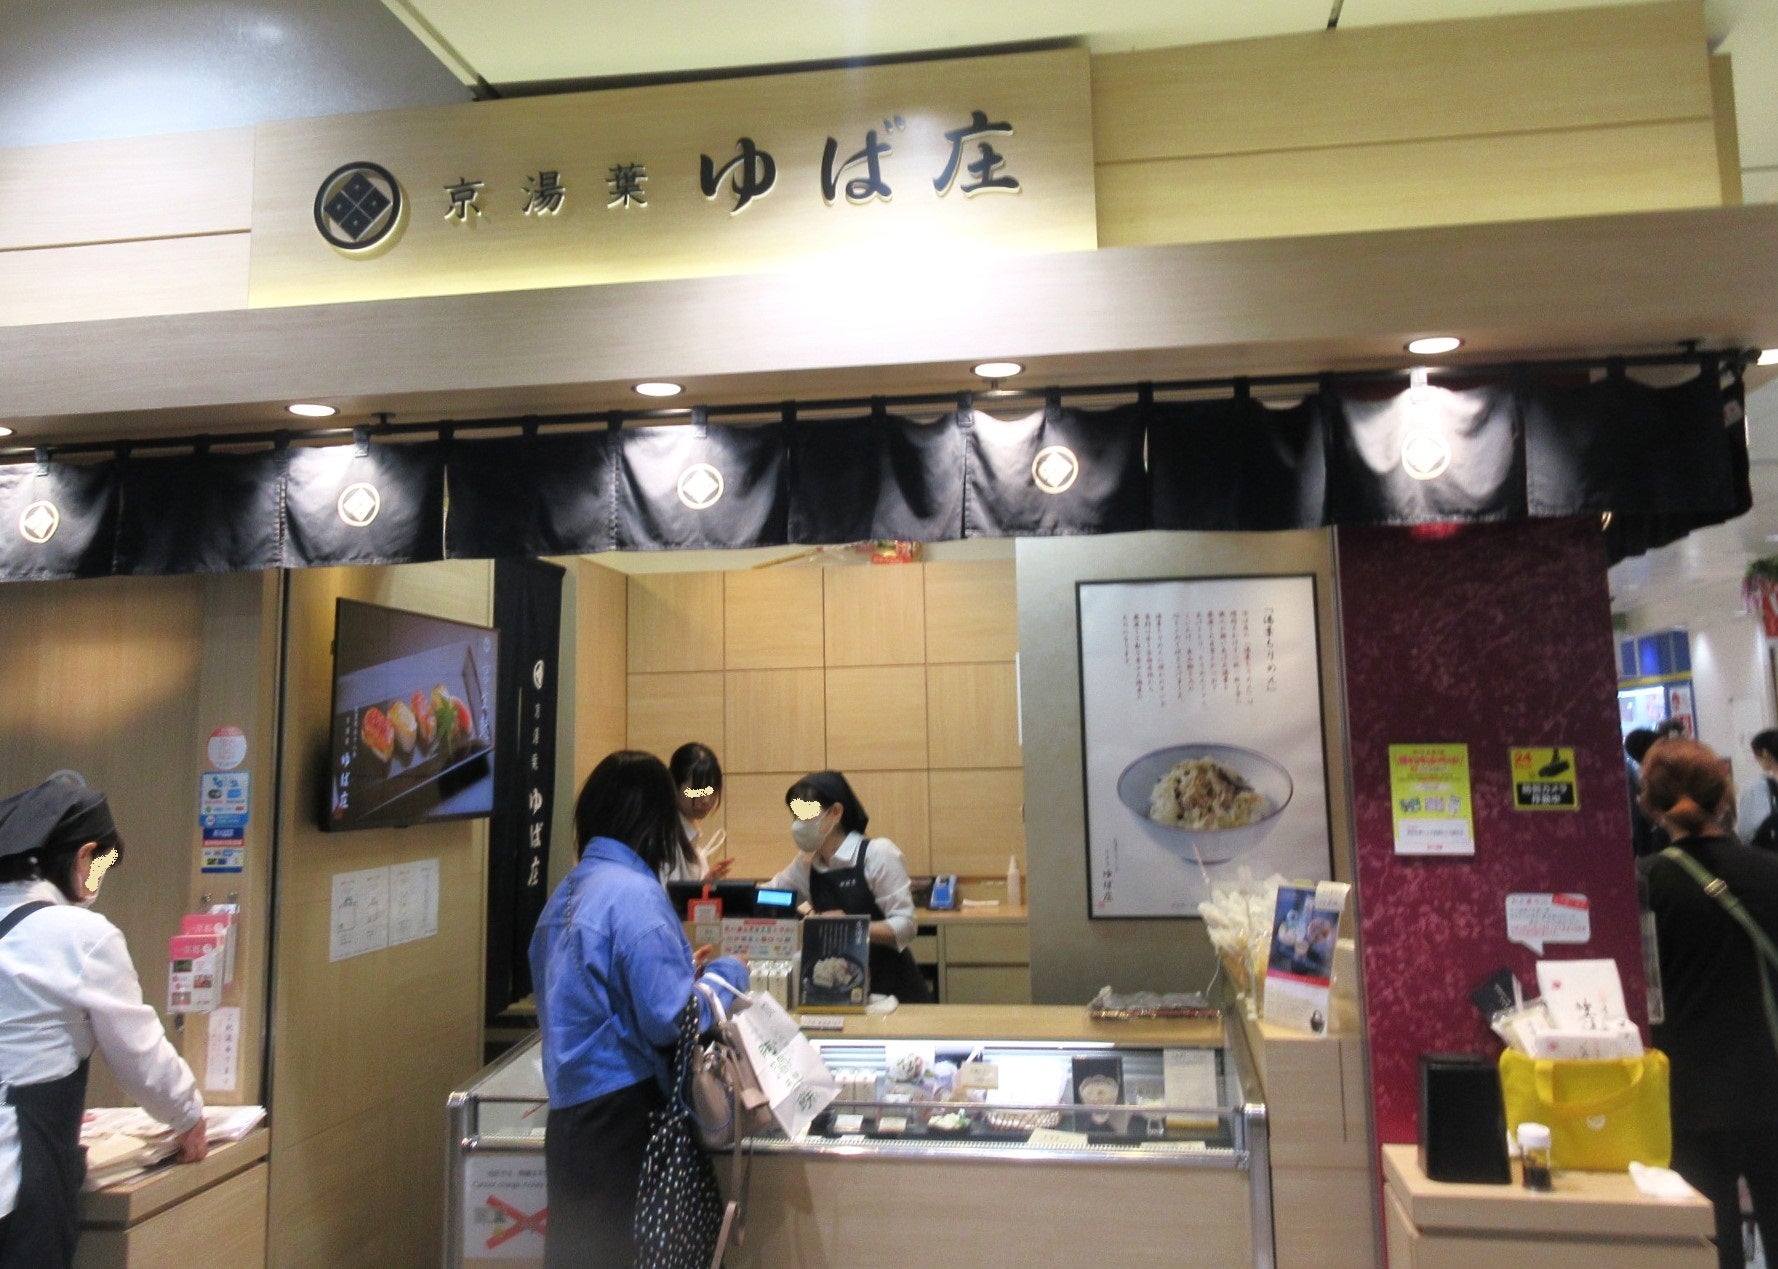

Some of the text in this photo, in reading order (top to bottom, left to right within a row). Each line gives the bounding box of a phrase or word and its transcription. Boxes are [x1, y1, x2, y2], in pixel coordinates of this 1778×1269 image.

[443, 110, 1023, 222] 京湯葉 ゆば庄
